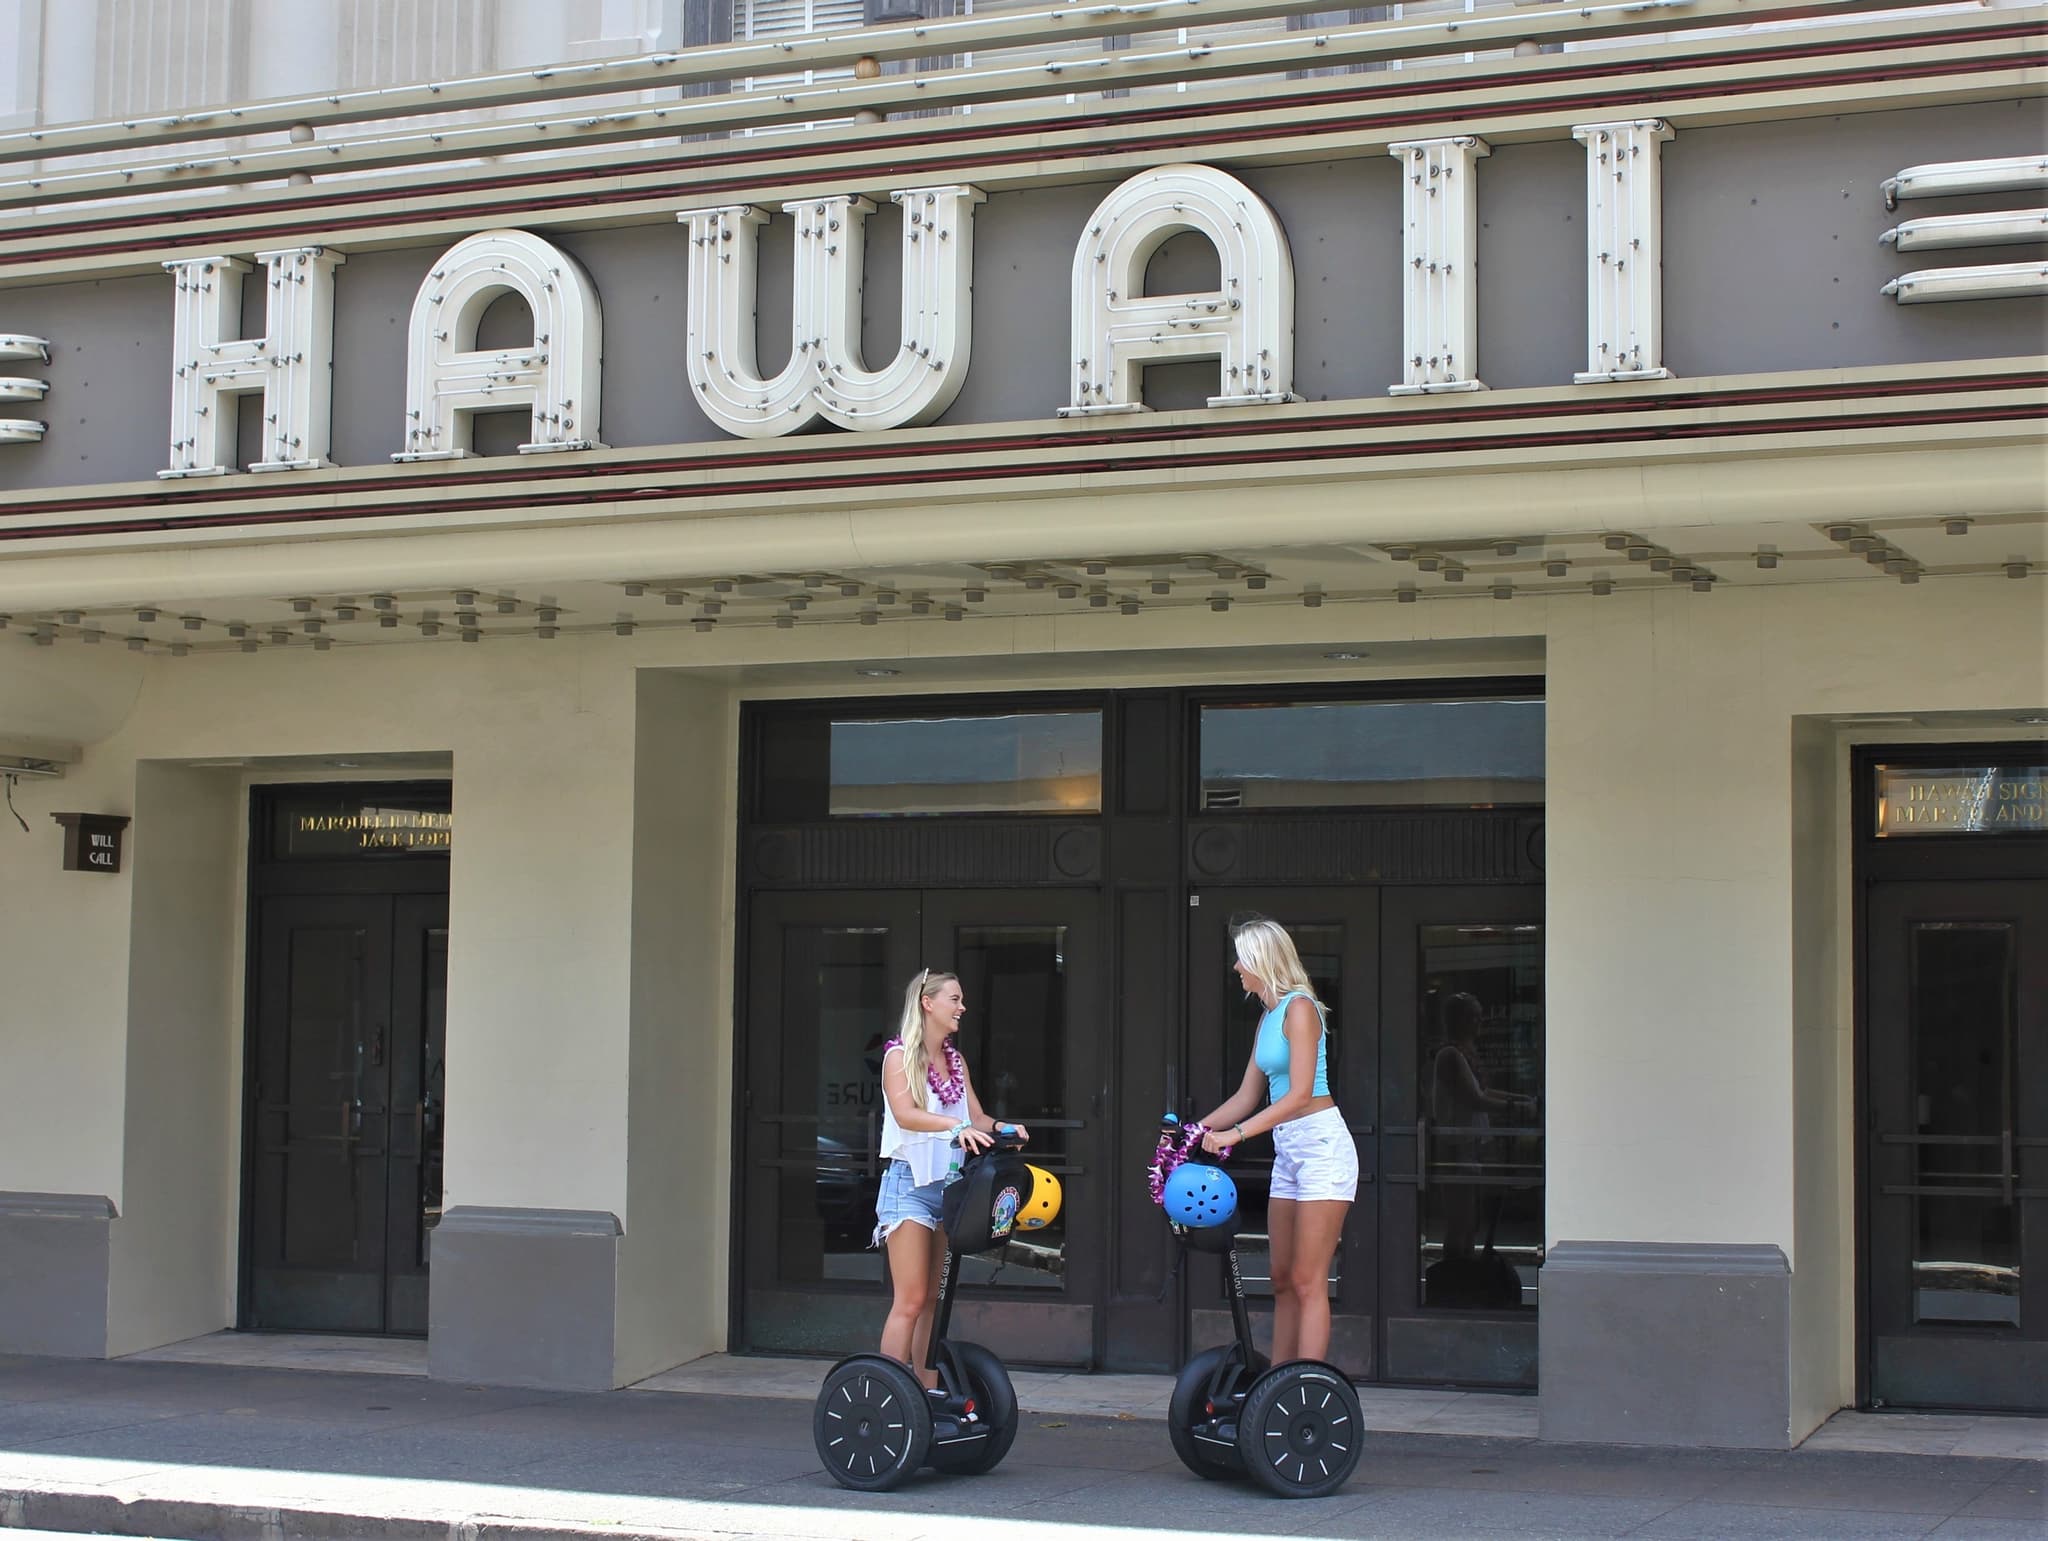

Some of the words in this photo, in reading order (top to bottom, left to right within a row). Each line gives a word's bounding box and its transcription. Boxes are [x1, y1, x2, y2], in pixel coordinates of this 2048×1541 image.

[157, 119, 1676, 479] HAWAII
[1896, 805, 1965, 822] MARY
[1995, 803, 2043, 821] AND
[300, 815, 386, 832] MARQUEE
[91, 834, 114, 847] WILL
[359, 832, 403, 847] JACK
[89, 852, 113, 865] CALL
